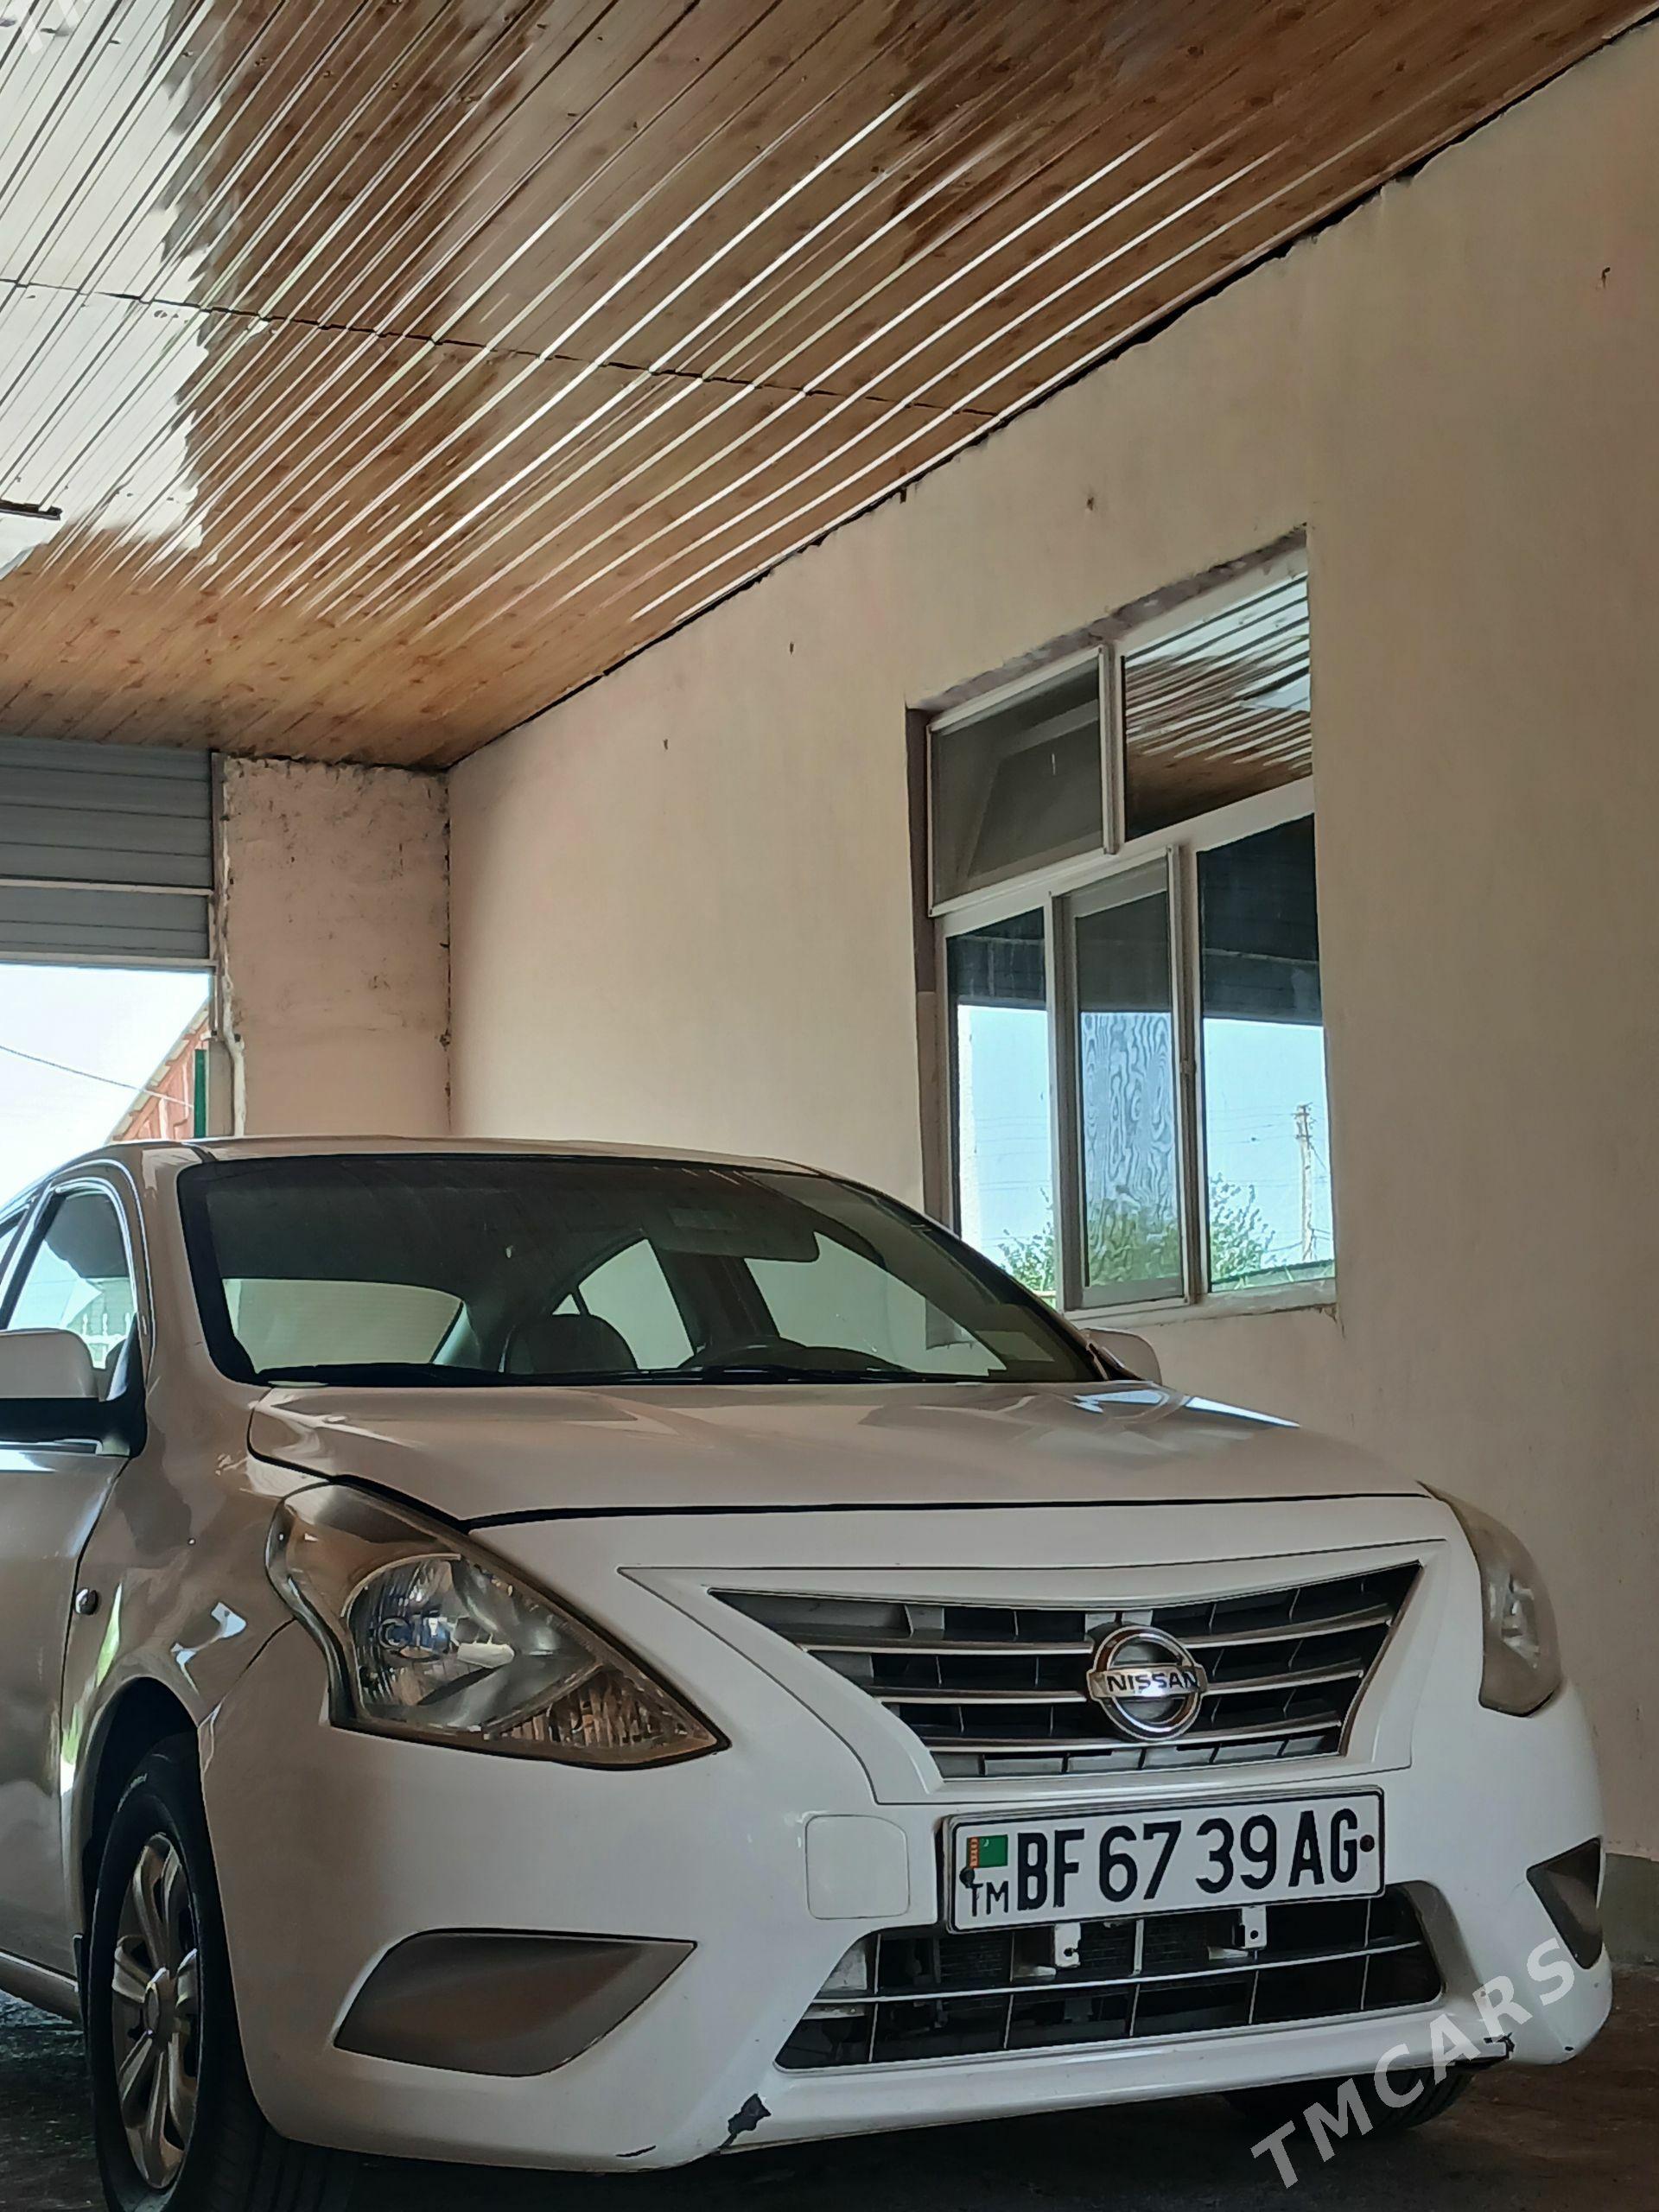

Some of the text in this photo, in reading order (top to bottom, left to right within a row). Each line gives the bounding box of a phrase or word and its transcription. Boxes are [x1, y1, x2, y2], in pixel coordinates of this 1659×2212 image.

[1107, 1671, 1199, 1692] NISSAN
[1016, 1808, 1358, 1911] BF 67 39 AG
[969, 1880, 1009, 1917] TM
